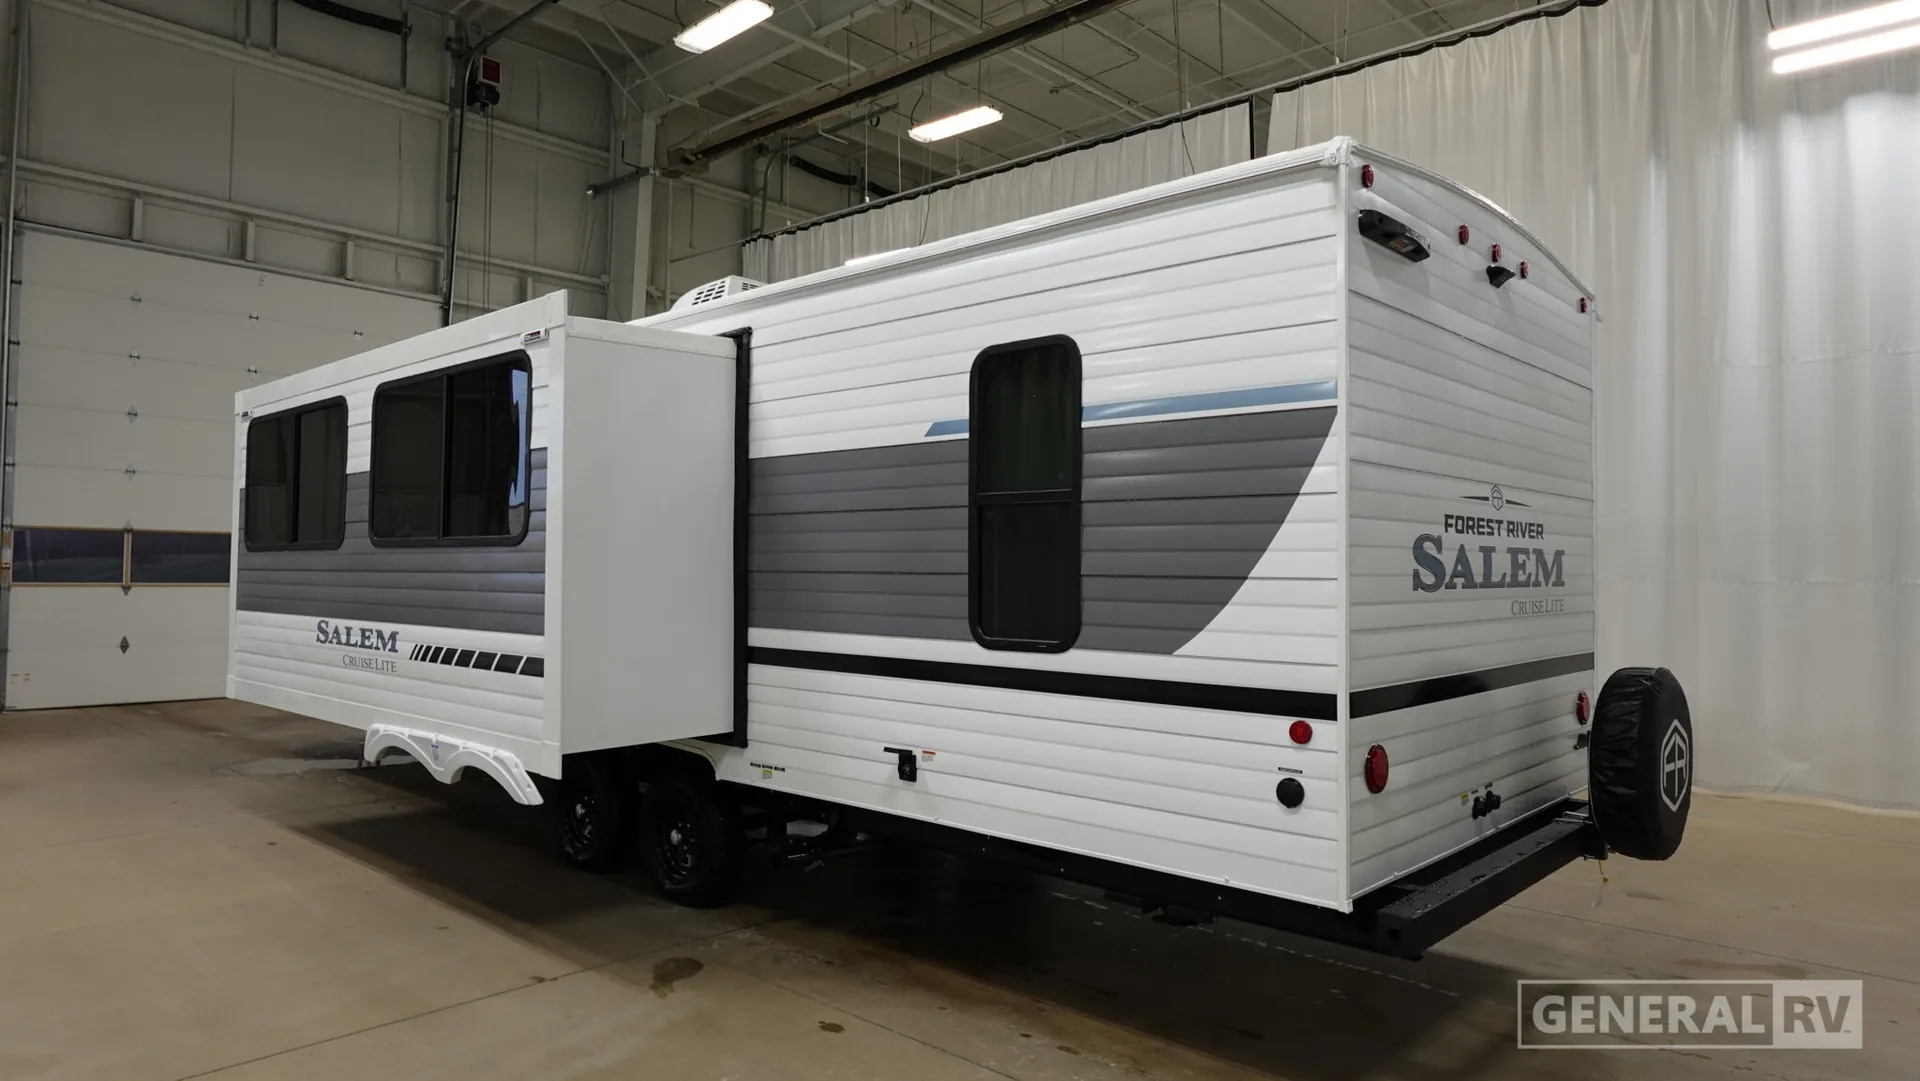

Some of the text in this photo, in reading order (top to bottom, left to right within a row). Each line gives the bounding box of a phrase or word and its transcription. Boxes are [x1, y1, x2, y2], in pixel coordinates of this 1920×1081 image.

[1444, 514, 1544, 540] FOREST RIVER
[1412, 533, 1566, 593] SALEM
[316, 619, 399, 653] SALEM
